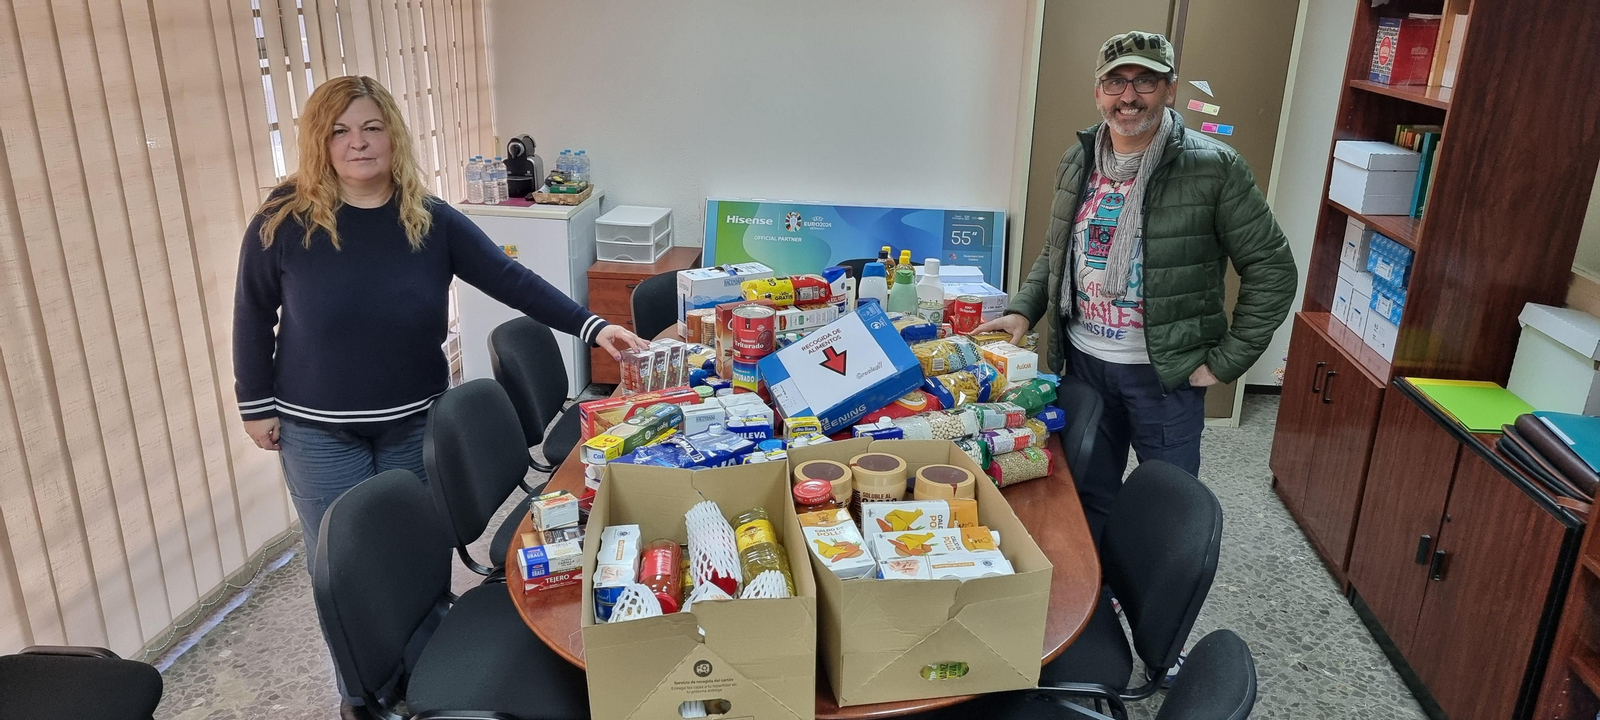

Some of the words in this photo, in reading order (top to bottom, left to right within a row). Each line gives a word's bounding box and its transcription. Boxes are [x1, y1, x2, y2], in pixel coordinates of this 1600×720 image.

[726, 215, 773, 226] Hisense
[735, 340, 764, 349] Triturado
[801, 331, 832, 352] RECOGIDA
[832, 328, 842, 336] DE
[808, 335, 842, 355] ALIMENTOS
[544, 574, 570, 584] TEJERO
